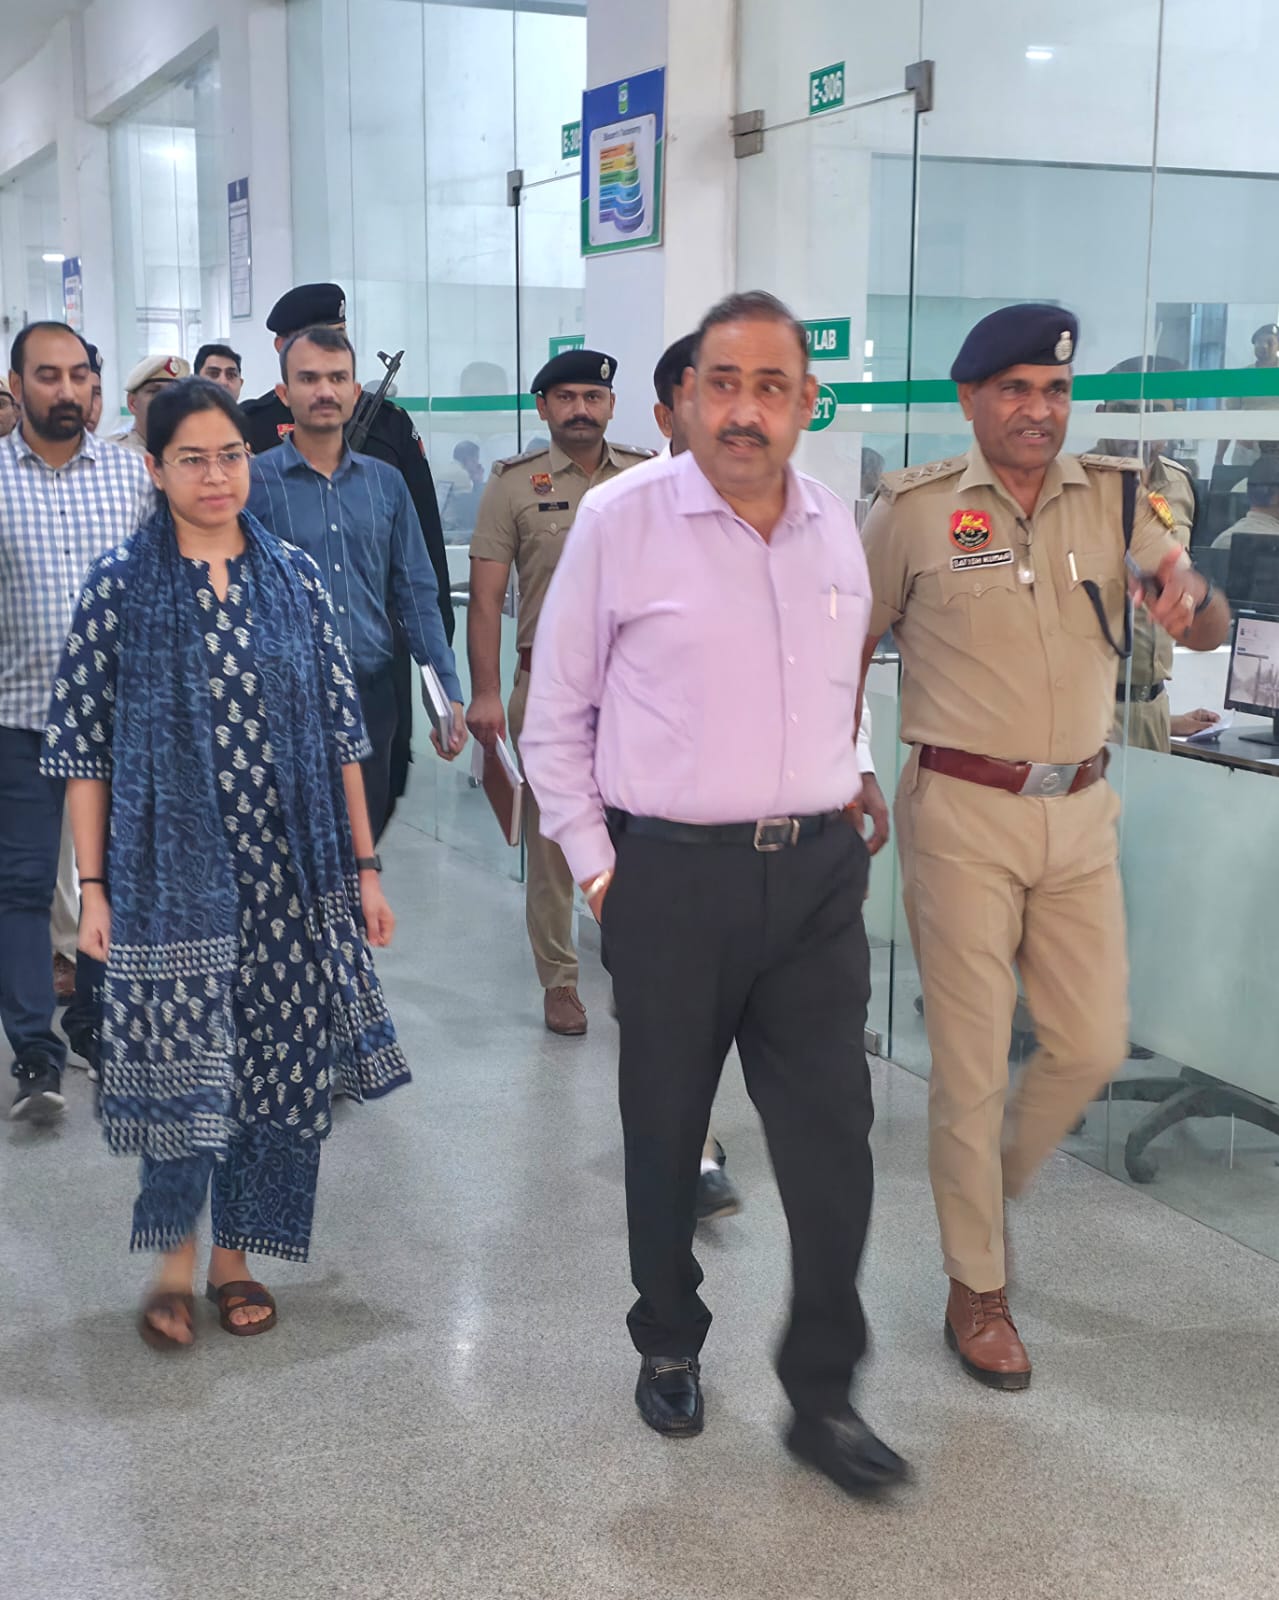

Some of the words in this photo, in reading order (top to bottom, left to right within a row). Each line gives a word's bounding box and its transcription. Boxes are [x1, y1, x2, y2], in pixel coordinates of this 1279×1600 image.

[812, 70, 842, 106] E-306
[563, 127, 581, 153] E-30
[814, 329, 837, 351] LAB
